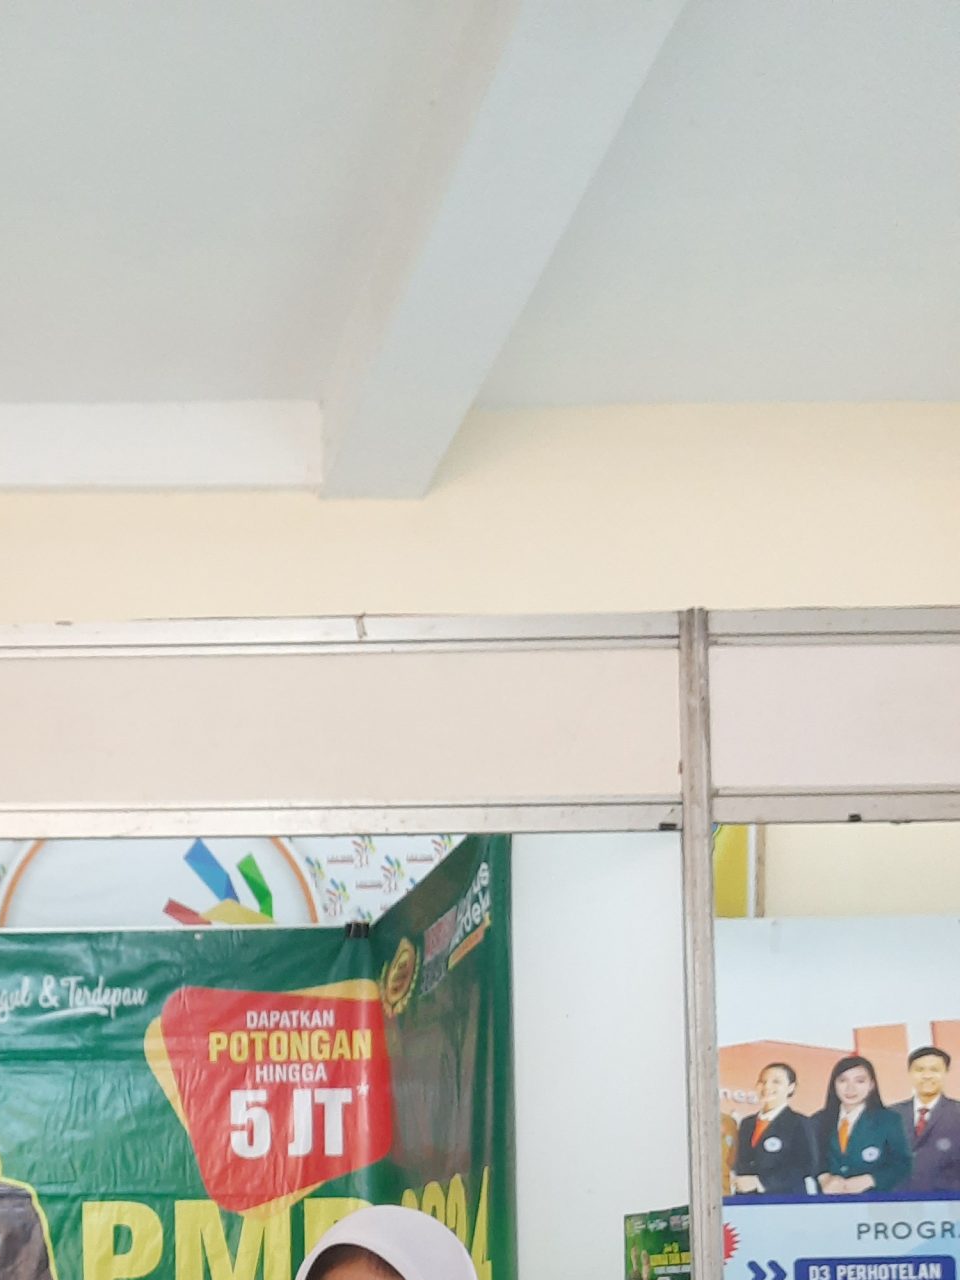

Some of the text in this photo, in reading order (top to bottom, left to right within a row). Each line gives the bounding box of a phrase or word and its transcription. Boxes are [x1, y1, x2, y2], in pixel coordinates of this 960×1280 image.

[39, 975, 61, 1009] &
[59, 975, 149, 1020] Terdepan
[246, 1009, 334, 1029] DAPATKAN
[208, 1028, 373, 1063] POTONGAN
[255, 1062, 328, 1083] HINGGA
[229, 1088, 271, 1159] 5
[857, 1221, 960, 1240] PROGR
